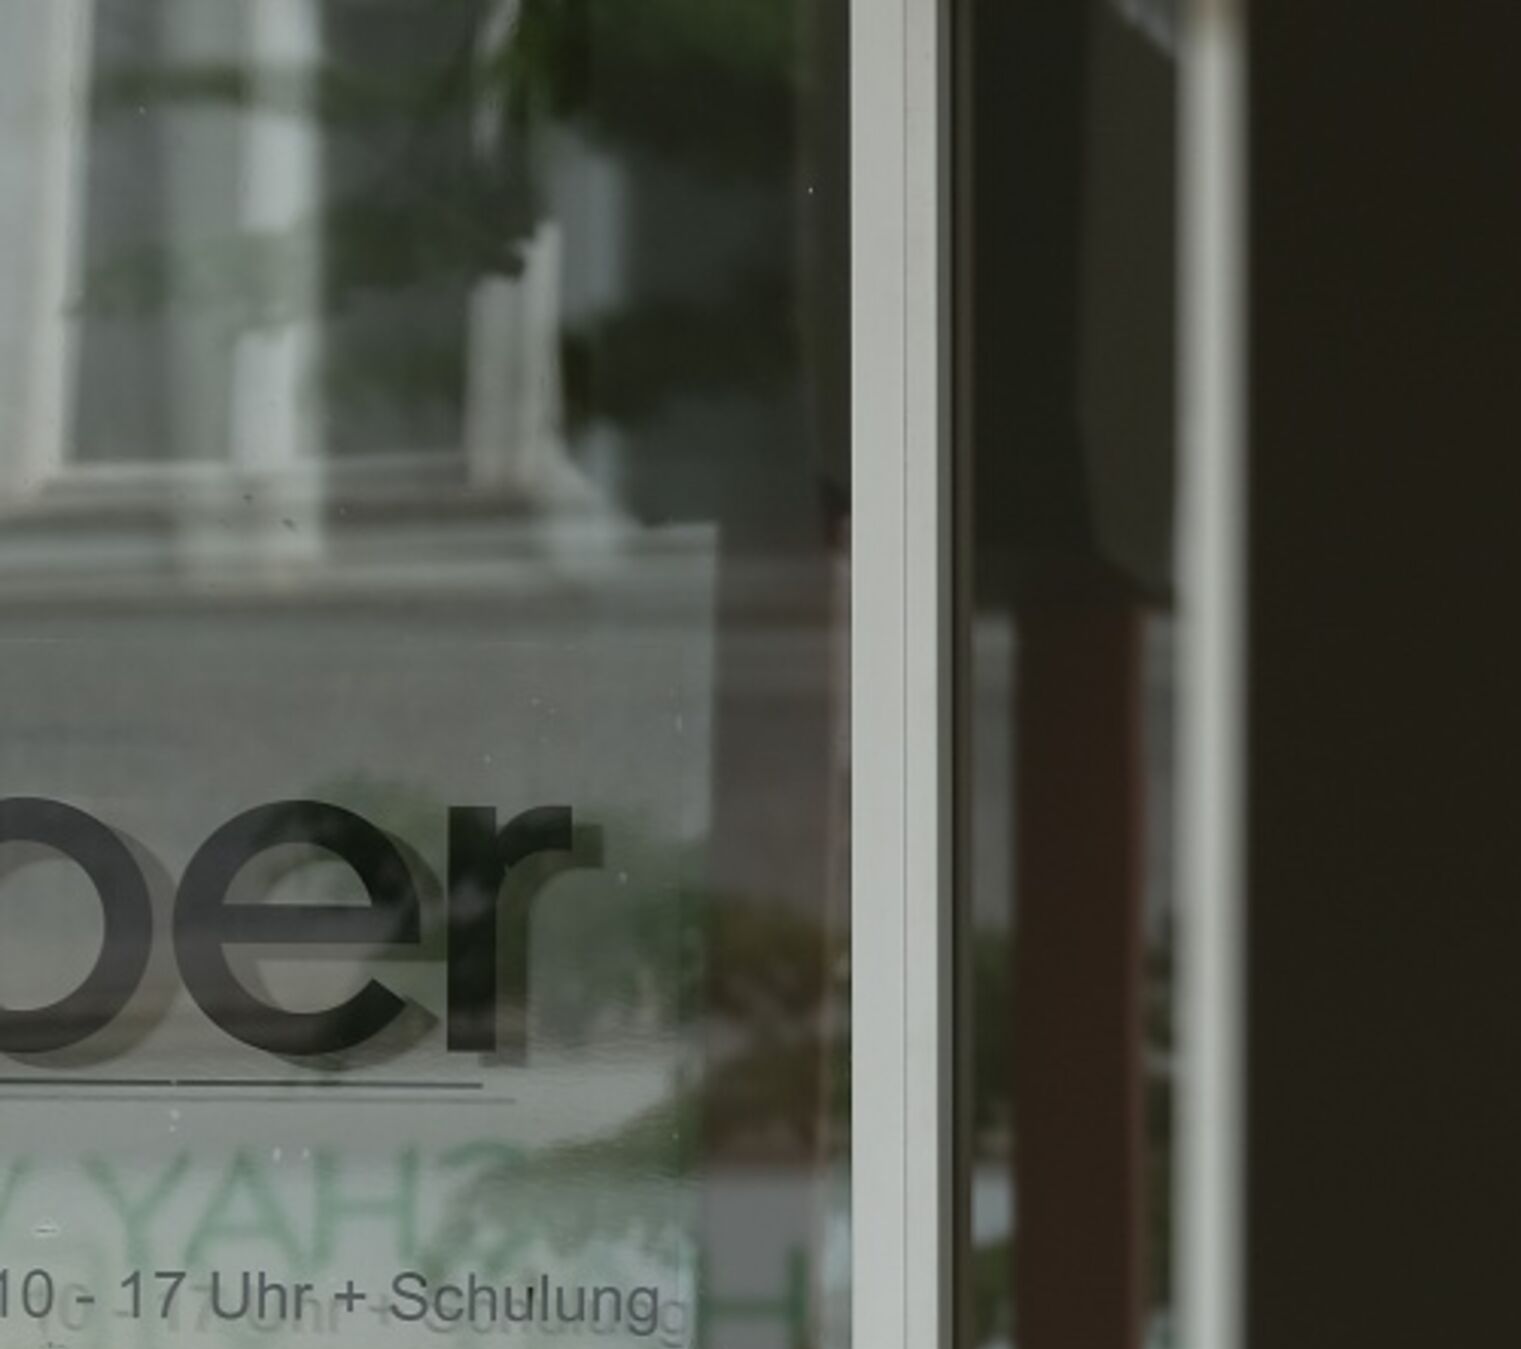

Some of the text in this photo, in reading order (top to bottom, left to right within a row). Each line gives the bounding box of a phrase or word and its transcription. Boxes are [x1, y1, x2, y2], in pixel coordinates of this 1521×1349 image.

[120, 1269, 187, 1319] 17
[211, 1270, 314, 1320] Uhr
[391, 1271, 659, 1336] Schulung
